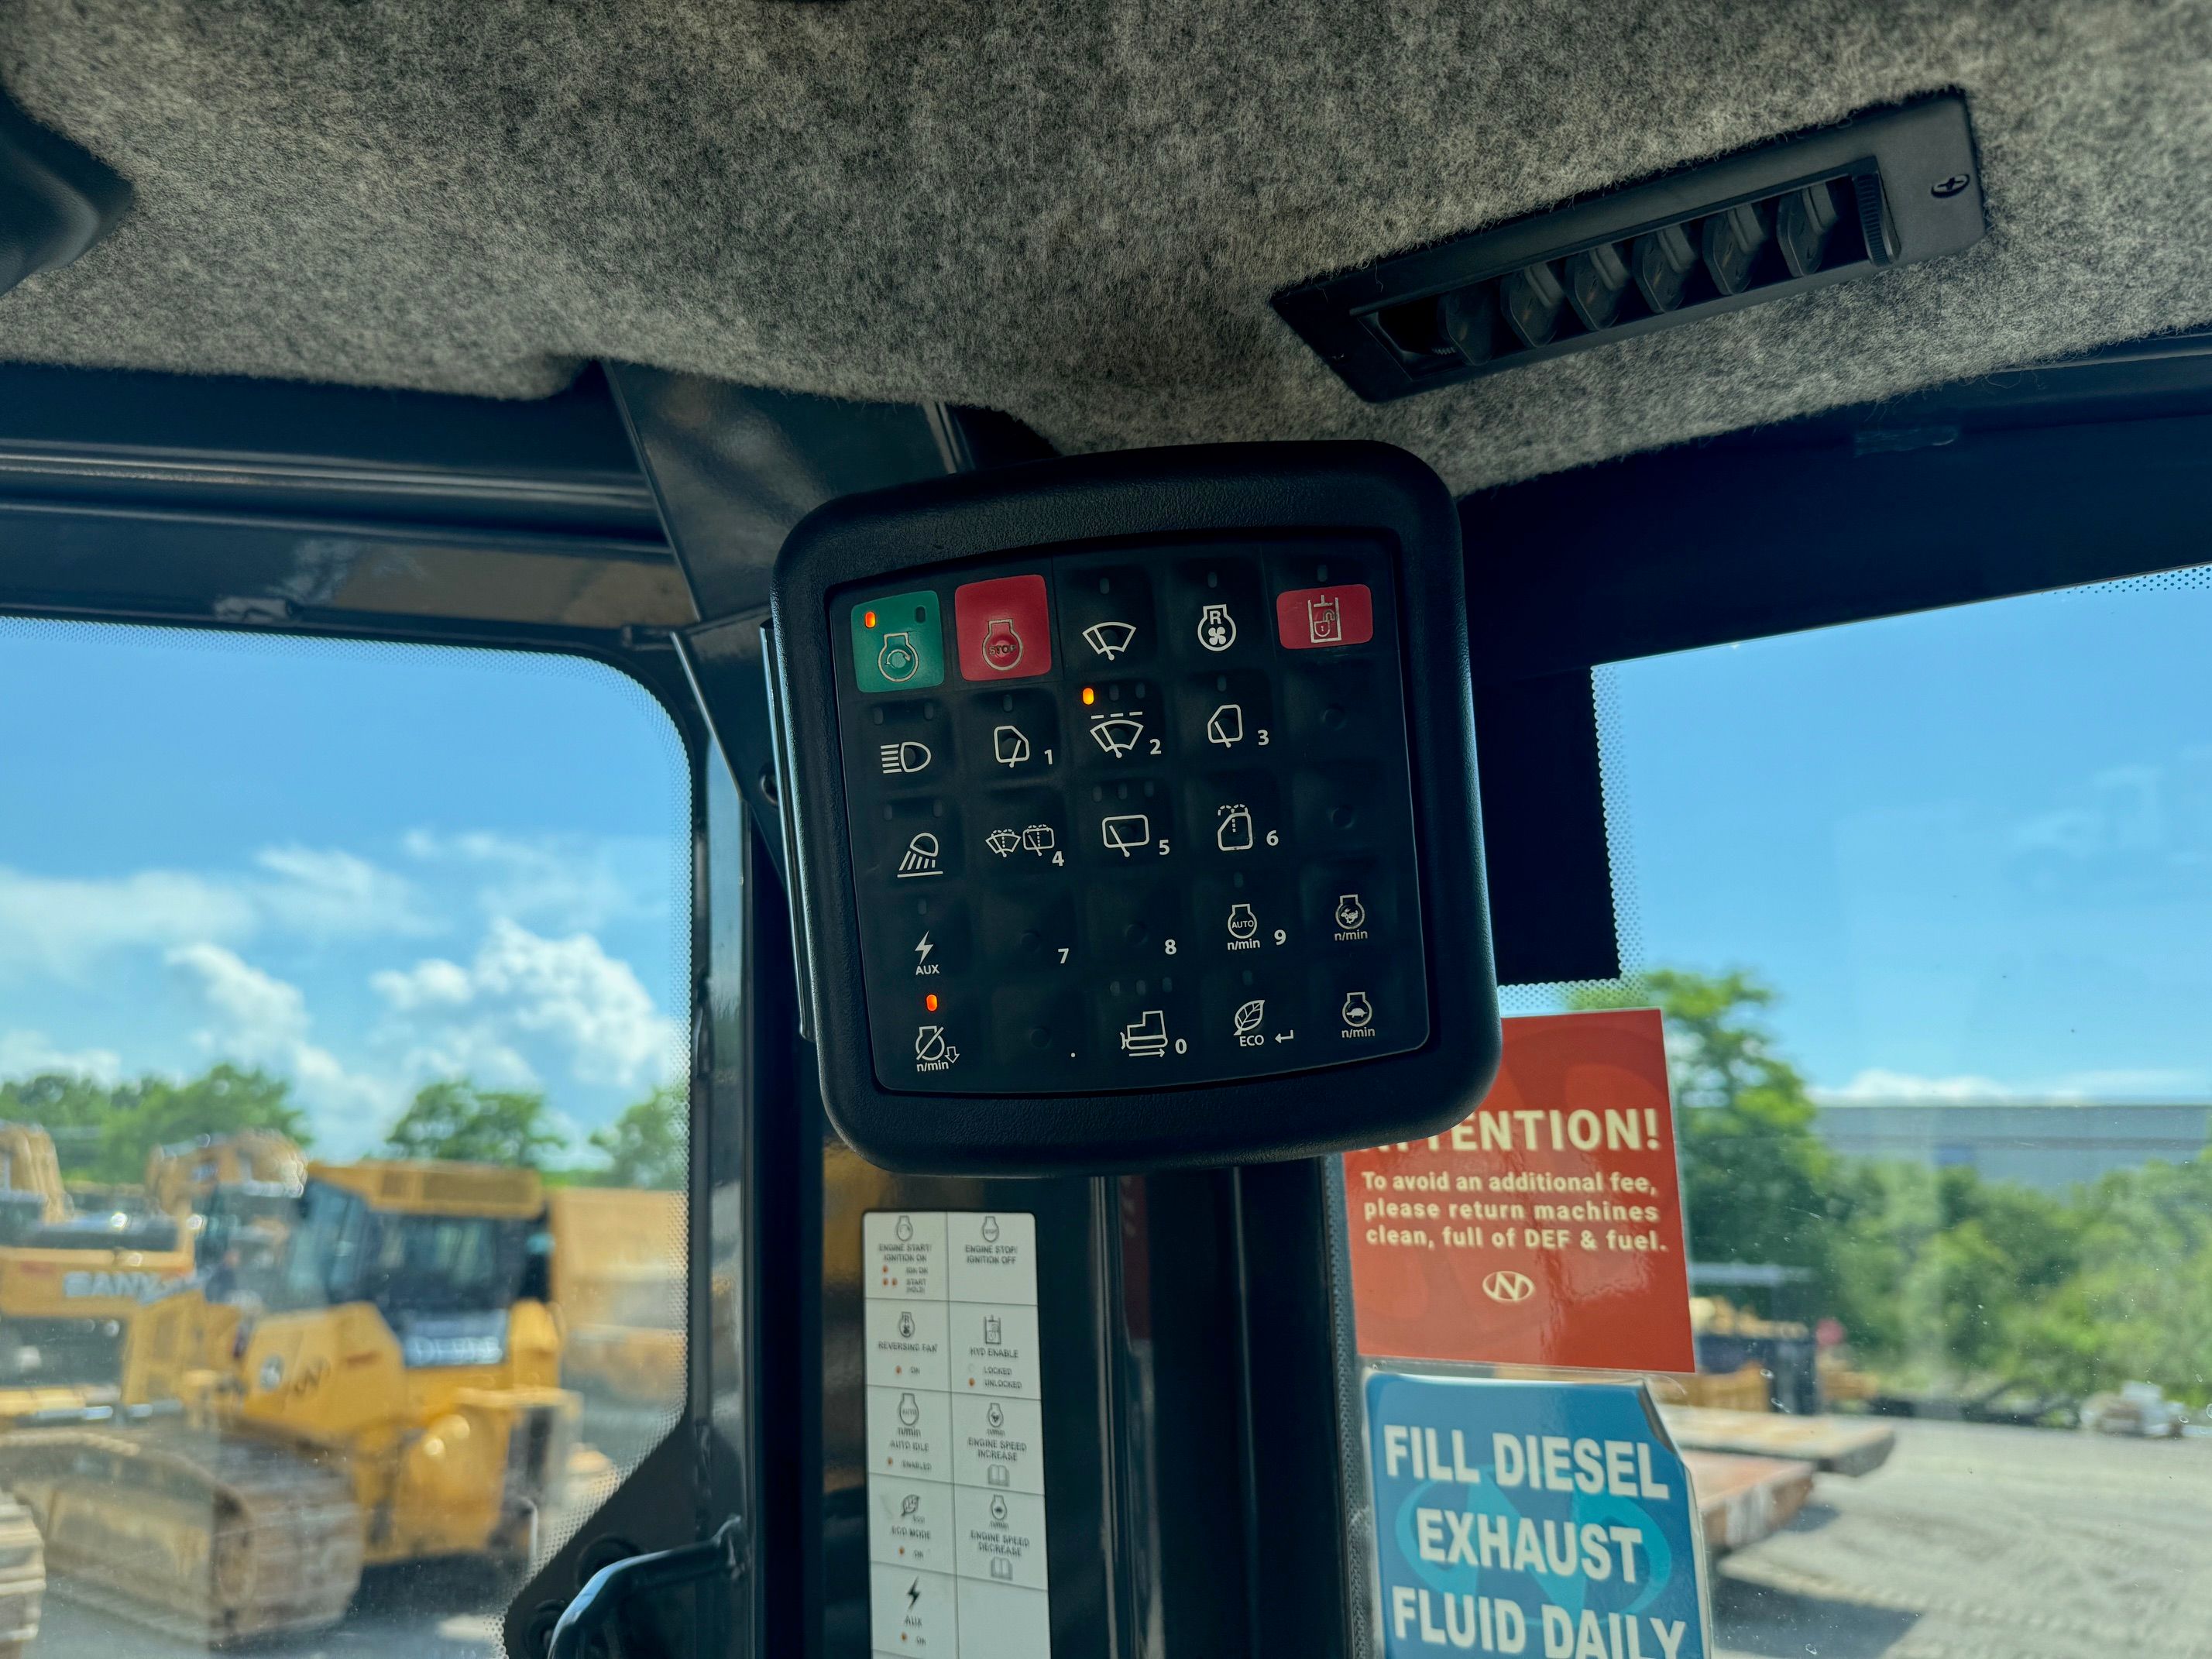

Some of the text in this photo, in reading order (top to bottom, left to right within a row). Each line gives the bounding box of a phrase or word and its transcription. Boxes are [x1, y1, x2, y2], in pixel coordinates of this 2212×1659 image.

[1210, 610, 1221, 625] R
[989, 644, 1017, 656] STOP
[1258, 730, 1270, 746] 3
[1149, 739, 1162, 755] 2
[1044, 749, 1053, 765] 1
[1266, 830, 1279, 847] 6
[1159, 840, 1170, 856] 5
[1052, 850, 1065, 867] 4
[1231, 919, 1255, 929] AUTO
[1274, 929, 1286, 946] 9
[1334, 930, 1369, 942] n/min
[1165, 939, 1177, 956] 8
[1227, 939, 1261, 951] n/min
[1057, 948, 1070, 964] 7
[915, 964, 940, 976] AUX
[1341, 1027, 1376, 1039] n/min
[1175, 1039, 1187, 1055] 0
[1239, 1035, 1265, 1047] ECO
[916, 1060, 950, 1073] n/min
[1361, 1108, 1662, 1152] ENTION!
[1362, 1172, 1657, 1197] To avoid an additional fee,
[1364, 1199, 1660, 1222] please return machines
[1365, 1226, 1668, 1252] clean, full of DEF & fuel.
[879, 1244, 905, 1252] ENGINE
[965, 1245, 993, 1253] ENGINE
[884, 1254, 927, 1262] IGNITION ON
[967, 1255, 1017, 1264] IGNITION OFF
[878, 1341, 938, 1353] REVERSING FAN
[988, 1348, 1019, 1358] ENABLE
[968, 1437, 1028, 1452] ENGINE SPEED
[977, 1449, 1018, 1462] INCREASE
[1382, 1424, 1671, 1501] FILL DIESEL
[1416, 1507, 1644, 1584] EXHAUST
[1390, 1585, 1687, 1659] FLUID DAILY
